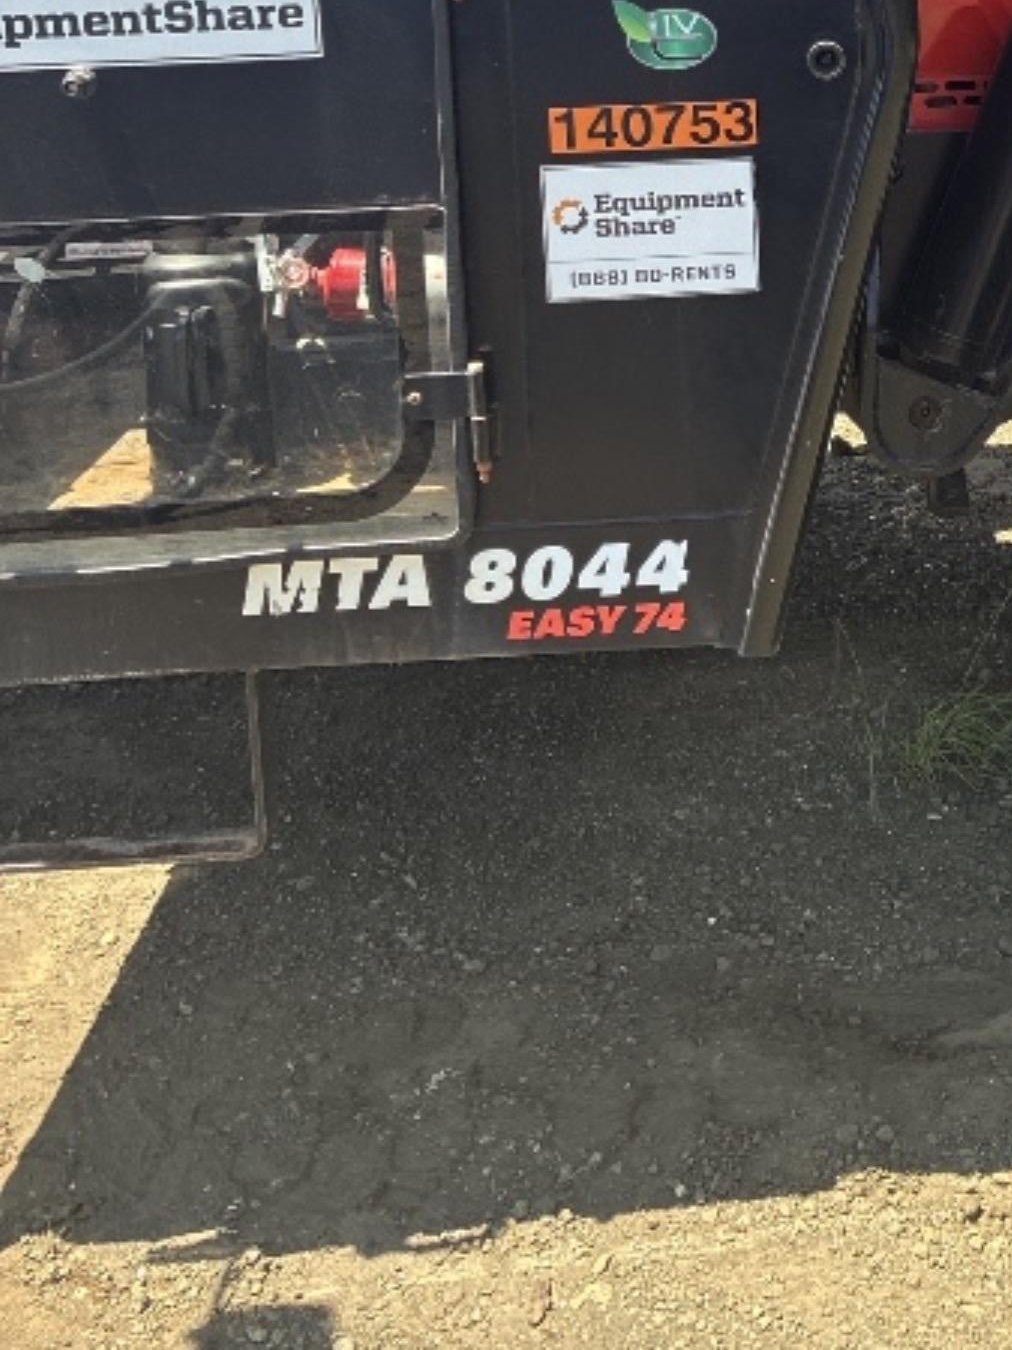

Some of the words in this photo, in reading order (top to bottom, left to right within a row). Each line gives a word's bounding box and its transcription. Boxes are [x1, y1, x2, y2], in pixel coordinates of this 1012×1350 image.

[0, 0, 304, 48] pmentShare
[554, 101, 754, 150] 140753
[594, 188, 744, 214] Equipment
[596, 216, 676, 238] Share
[241, 554, 432, 616] MTA
[463, 538, 689, 605] 8044
[506, 604, 627, 640] EASY
[632, 602, 687, 634] 74
